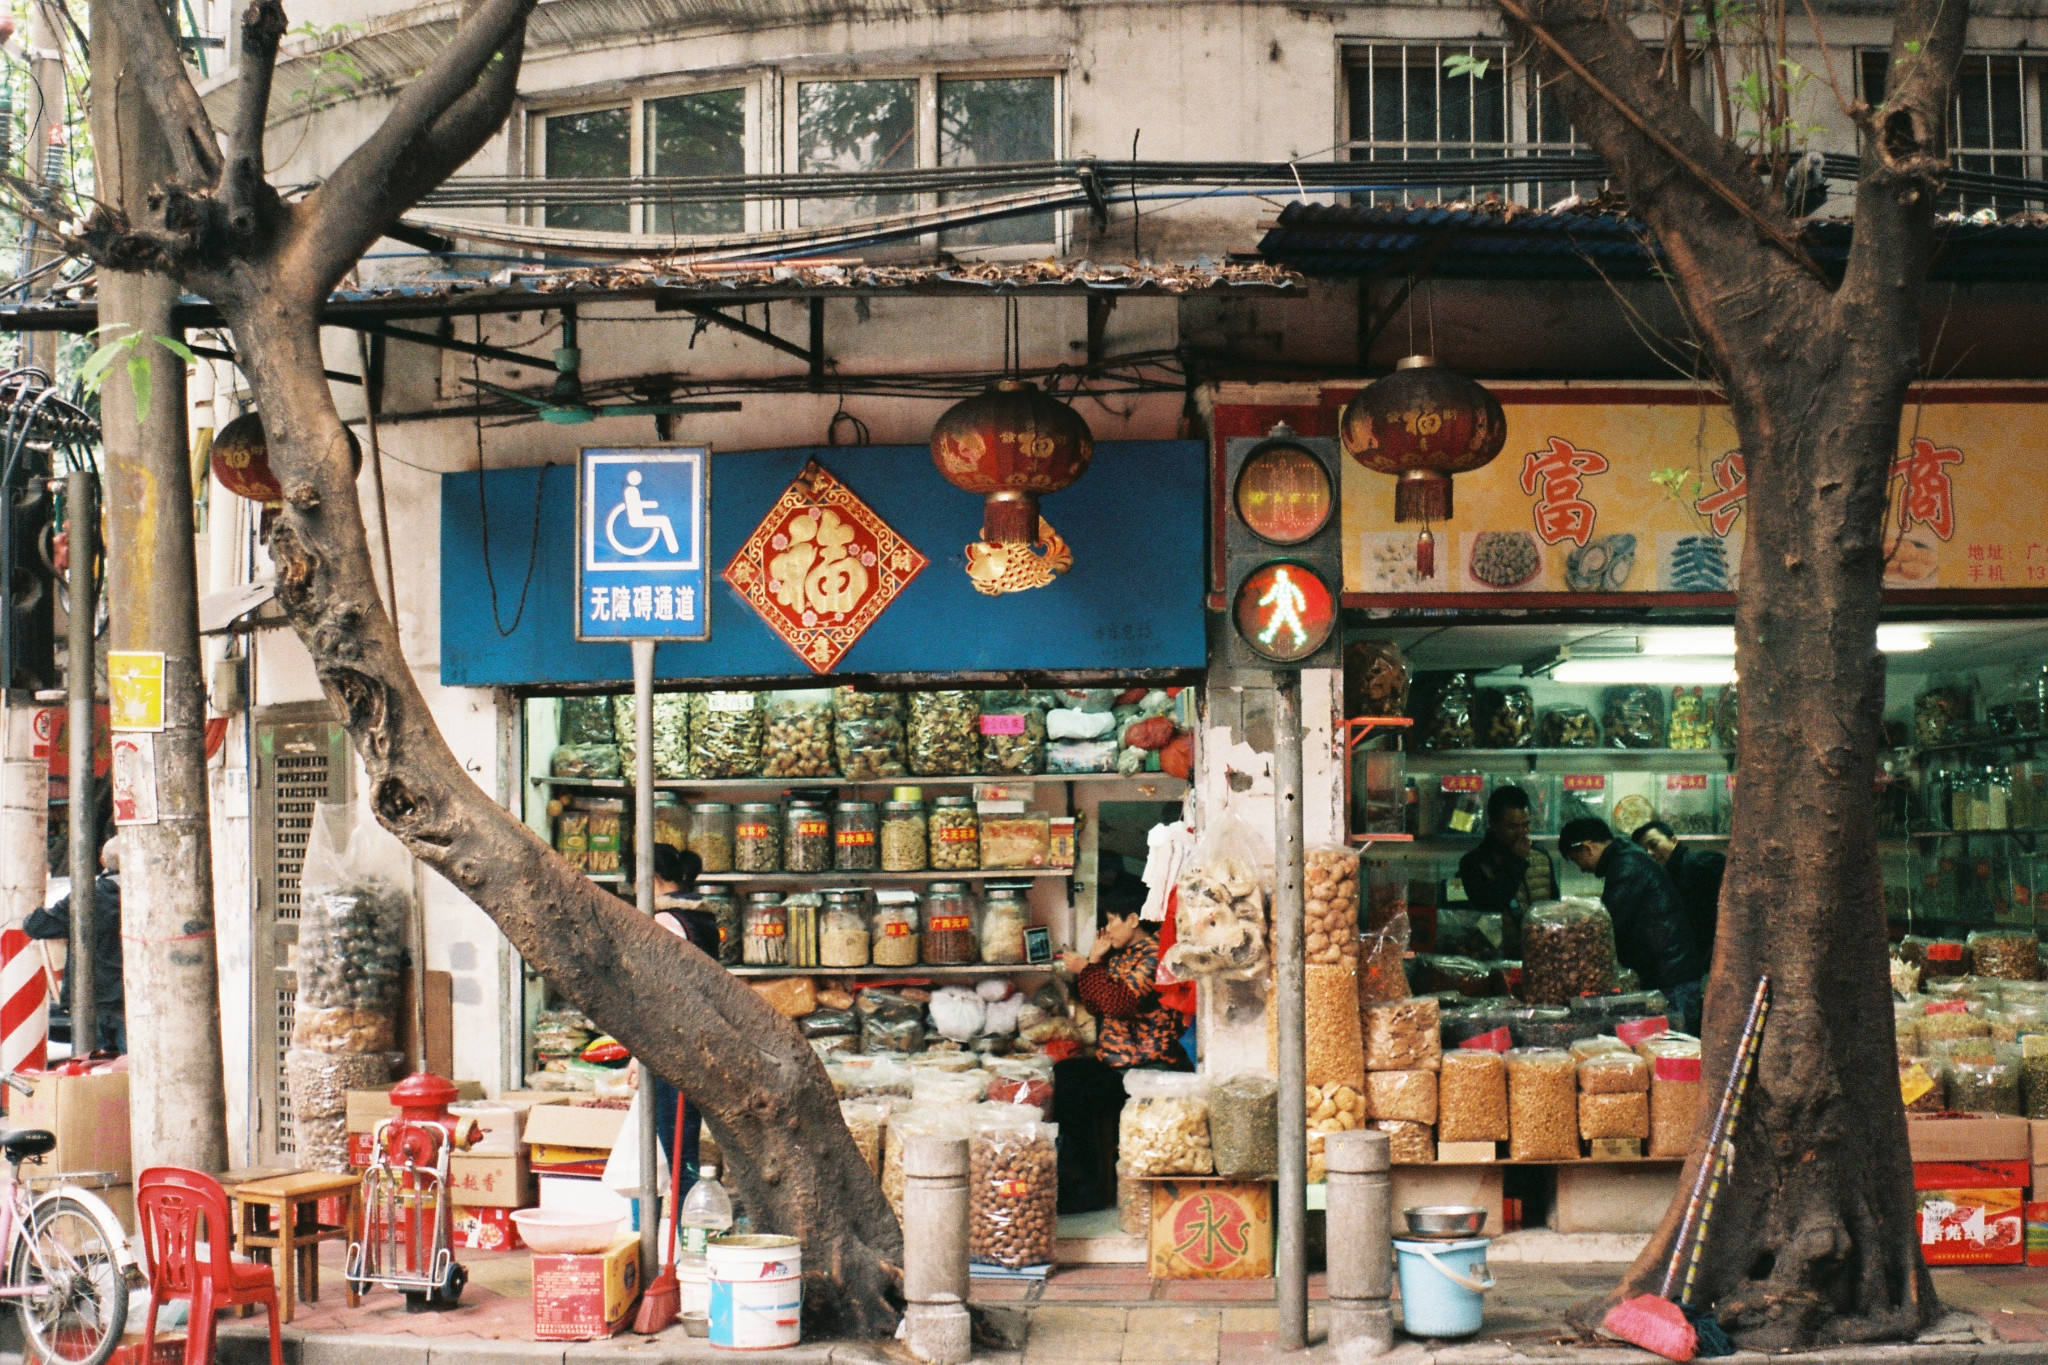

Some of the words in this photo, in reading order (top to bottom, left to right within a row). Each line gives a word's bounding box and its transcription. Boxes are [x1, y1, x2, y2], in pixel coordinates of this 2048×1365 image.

[769, 508, 869, 614] 福
[1967, 543, 2048, 561] 地址：广
[590, 585, 695, 622] 无障碍通道
